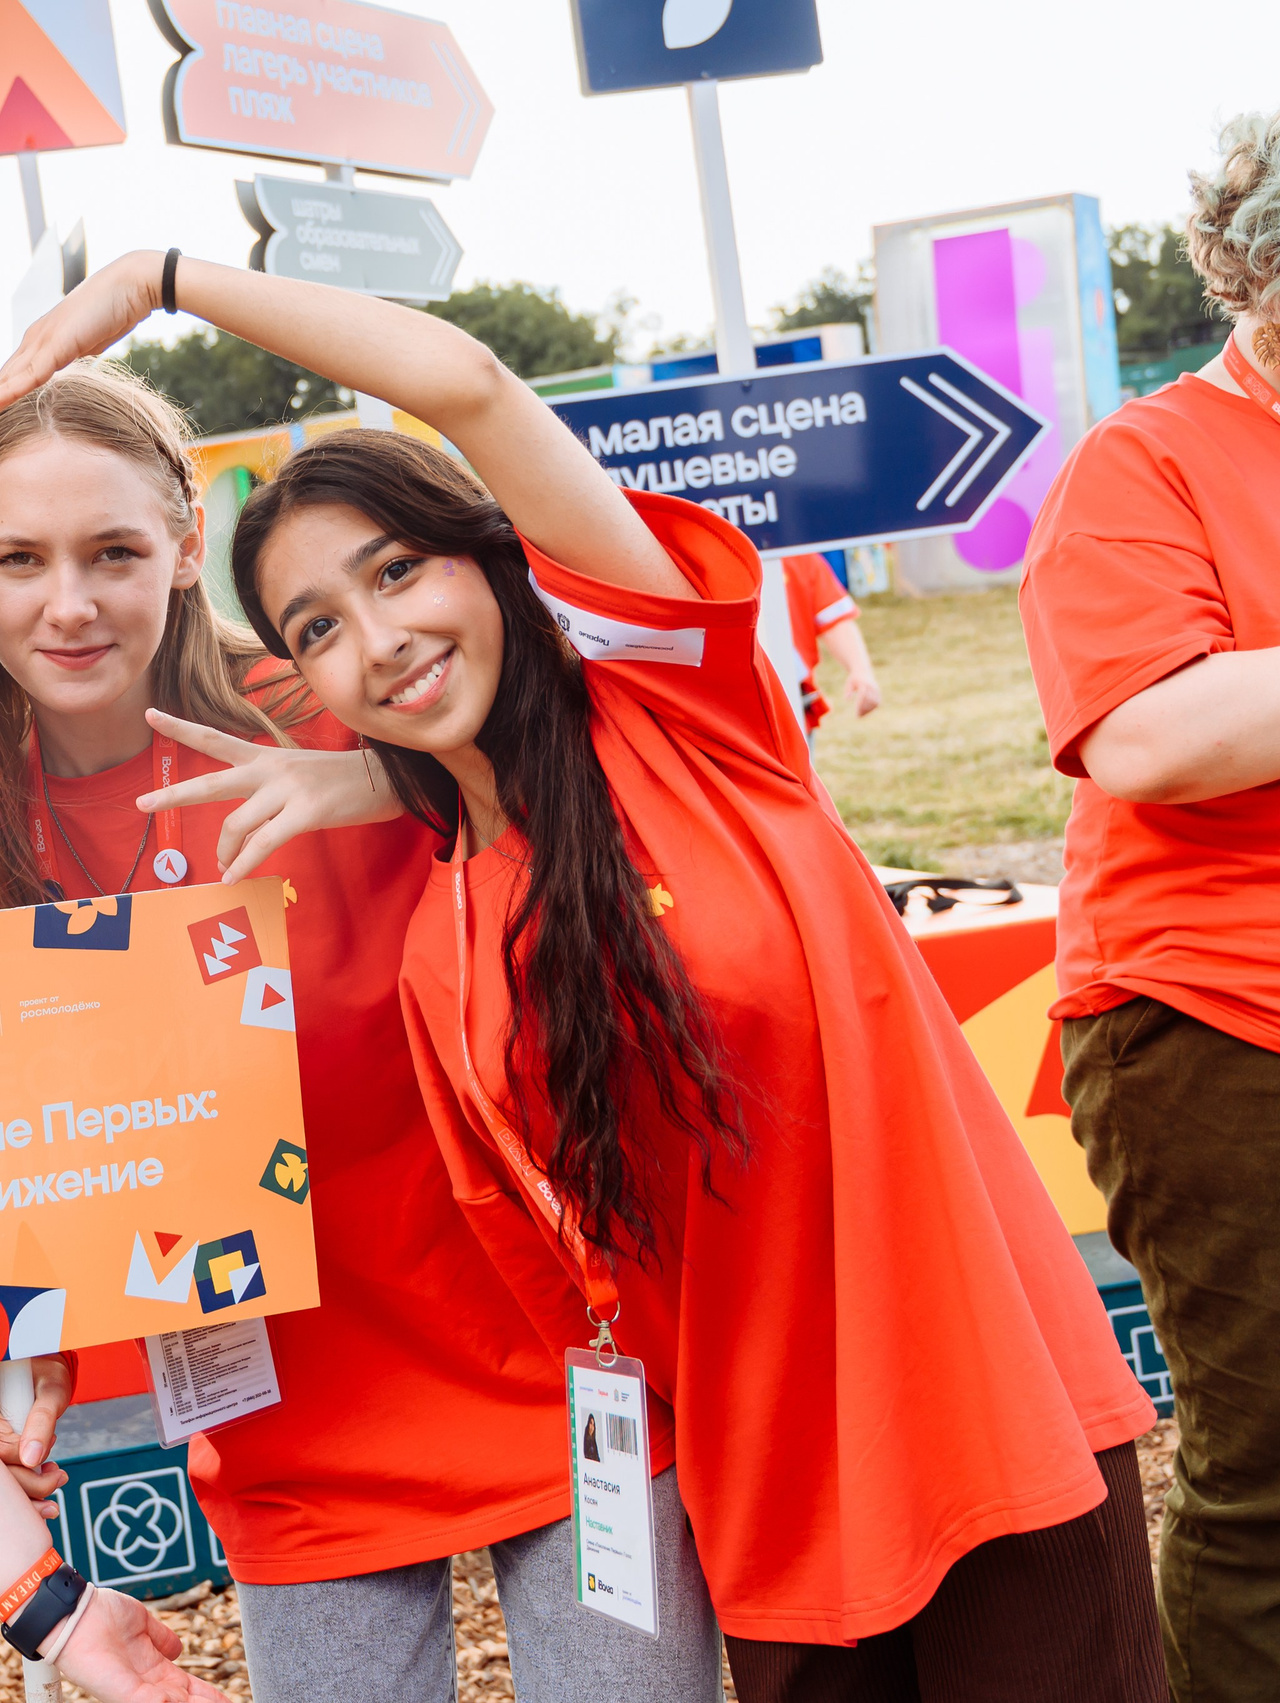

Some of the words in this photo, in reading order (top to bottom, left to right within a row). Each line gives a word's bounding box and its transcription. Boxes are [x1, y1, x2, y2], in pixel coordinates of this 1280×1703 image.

[316, 21, 385, 61] сцена
[224, 43, 307, 89] лагерь
[308, 60, 433, 109] участников
[228, 86, 295, 124] пляж
[588, 410, 724, 457] малая
[731, 391, 867, 439] сцена
[20, 997, 47, 1008] проект
[20, 1001, 101, 1022] росмолодёжь
[42, 1089, 218, 1143] Первых:
[583, 1472, 621, 1495] Анастасия
[585, 1515, 614, 1535] Наставник
